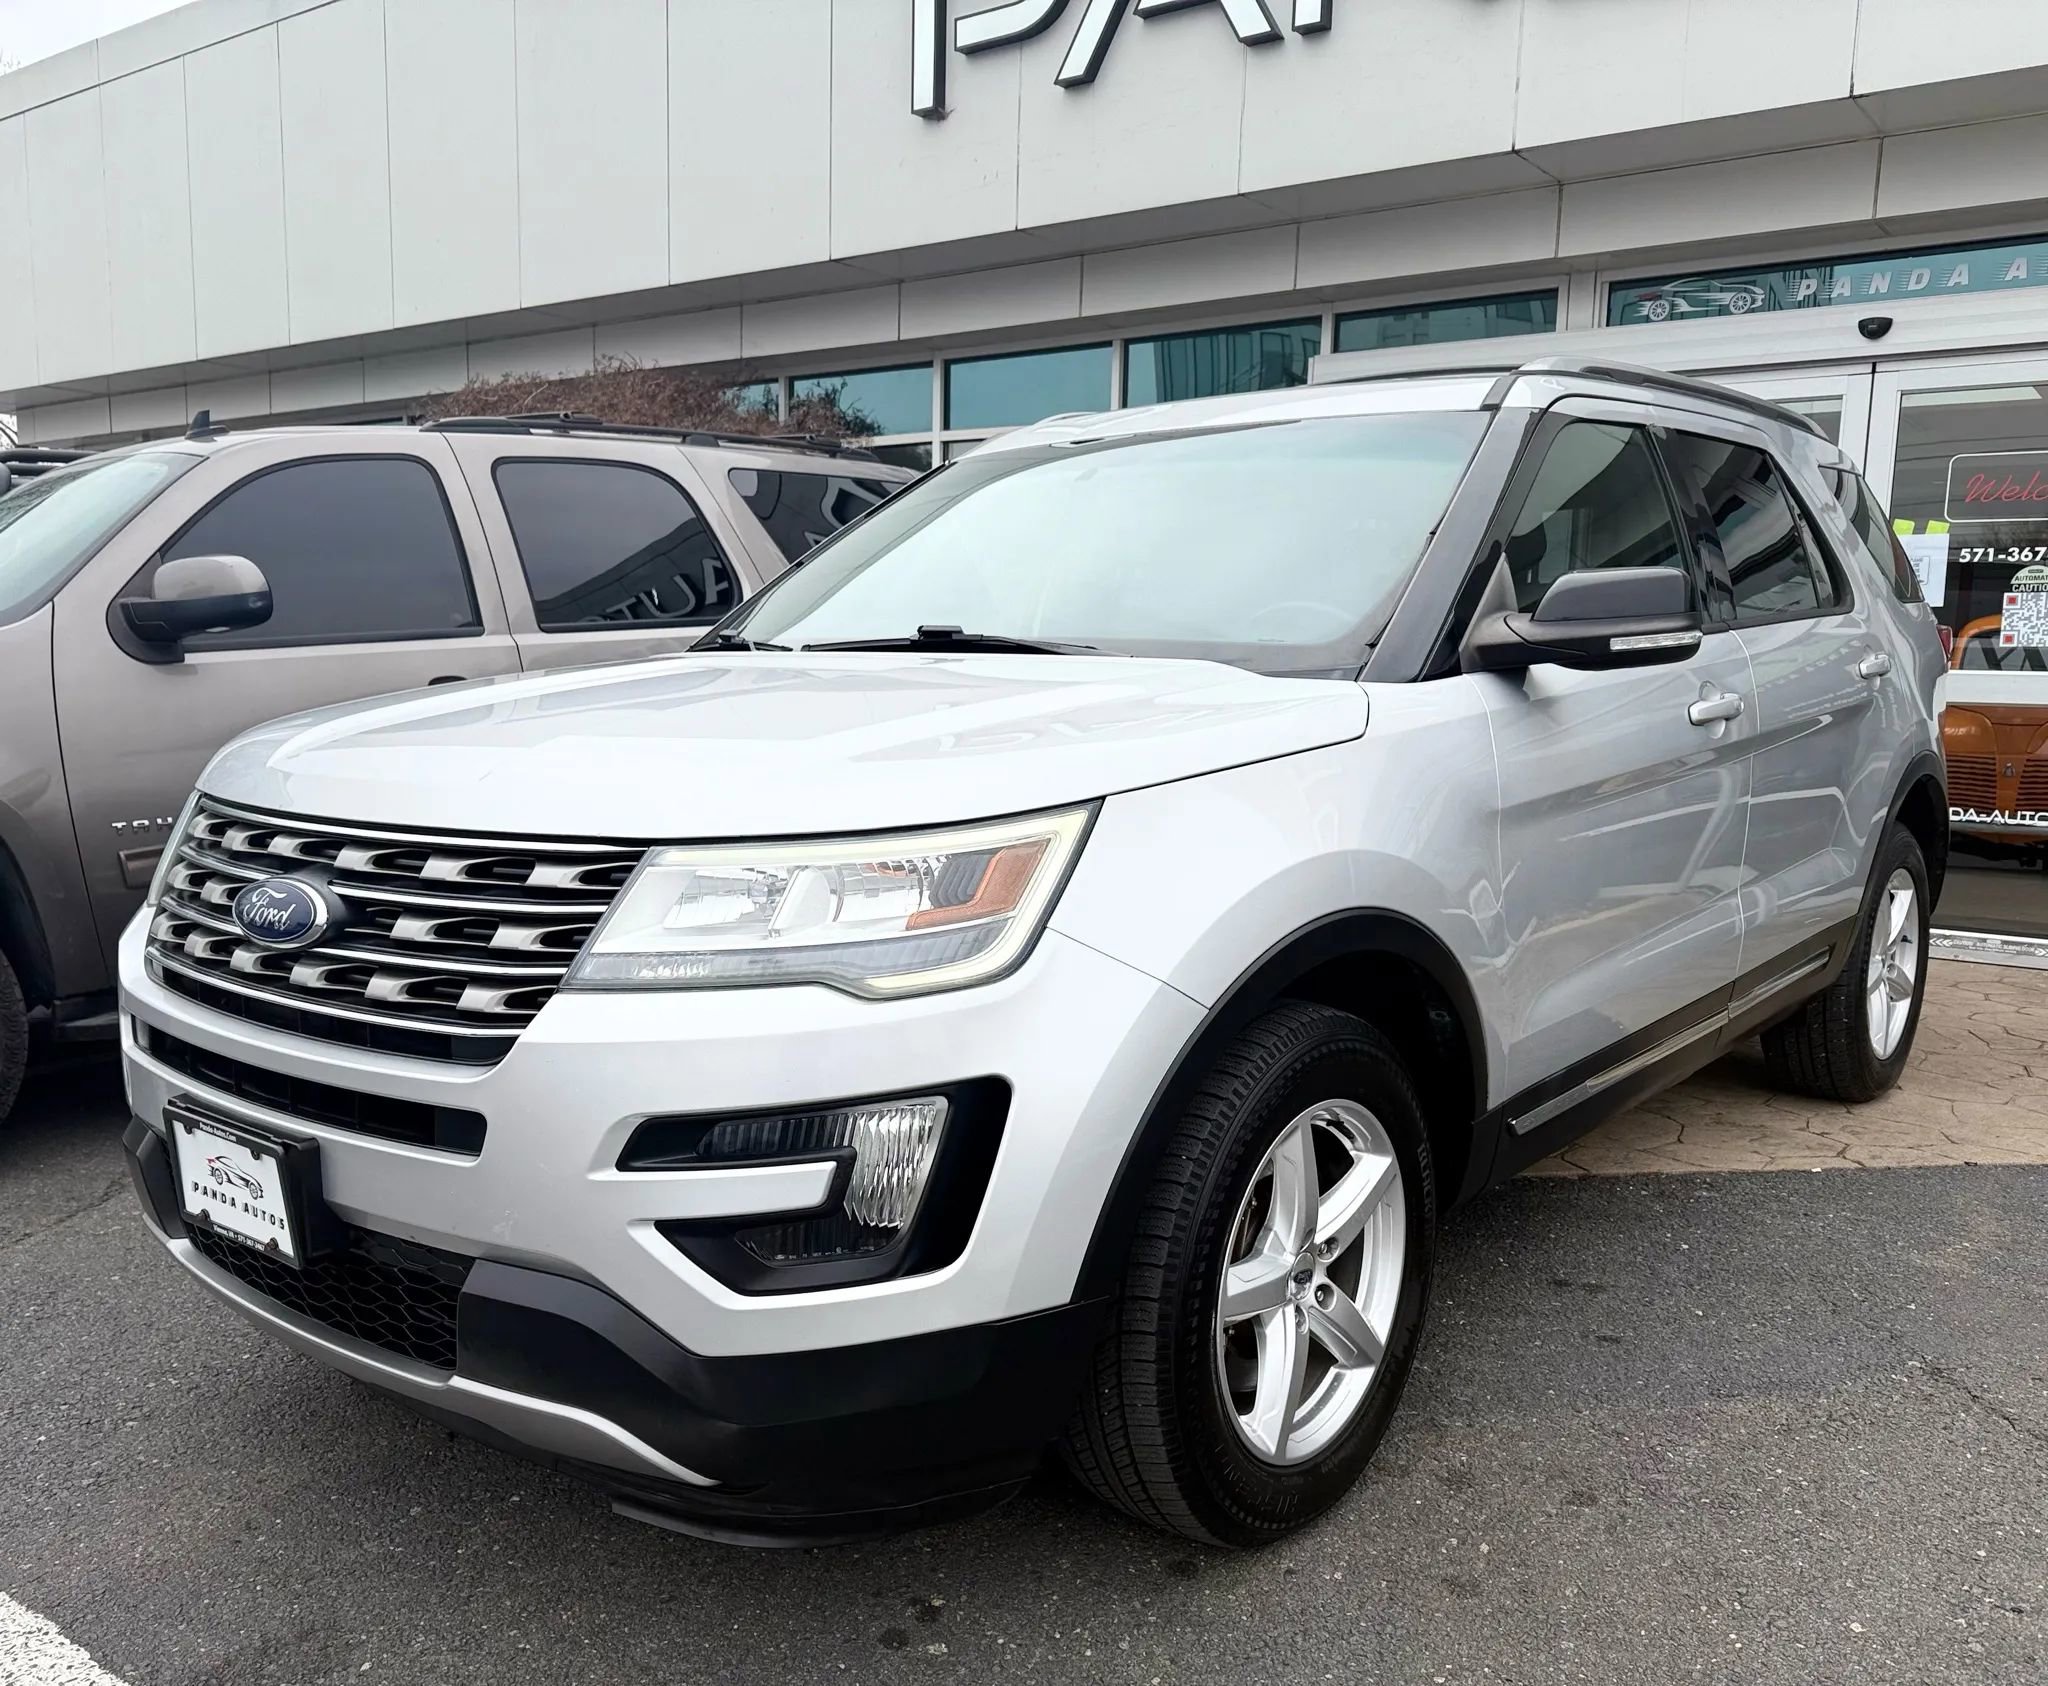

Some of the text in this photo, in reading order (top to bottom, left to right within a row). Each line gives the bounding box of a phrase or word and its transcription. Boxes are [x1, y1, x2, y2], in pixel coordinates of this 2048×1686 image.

[1793, 263, 1970, 301] PANDA
[243, 887, 296, 930] Ford
[193, 1181, 285, 1230] PANDA AUTOS
